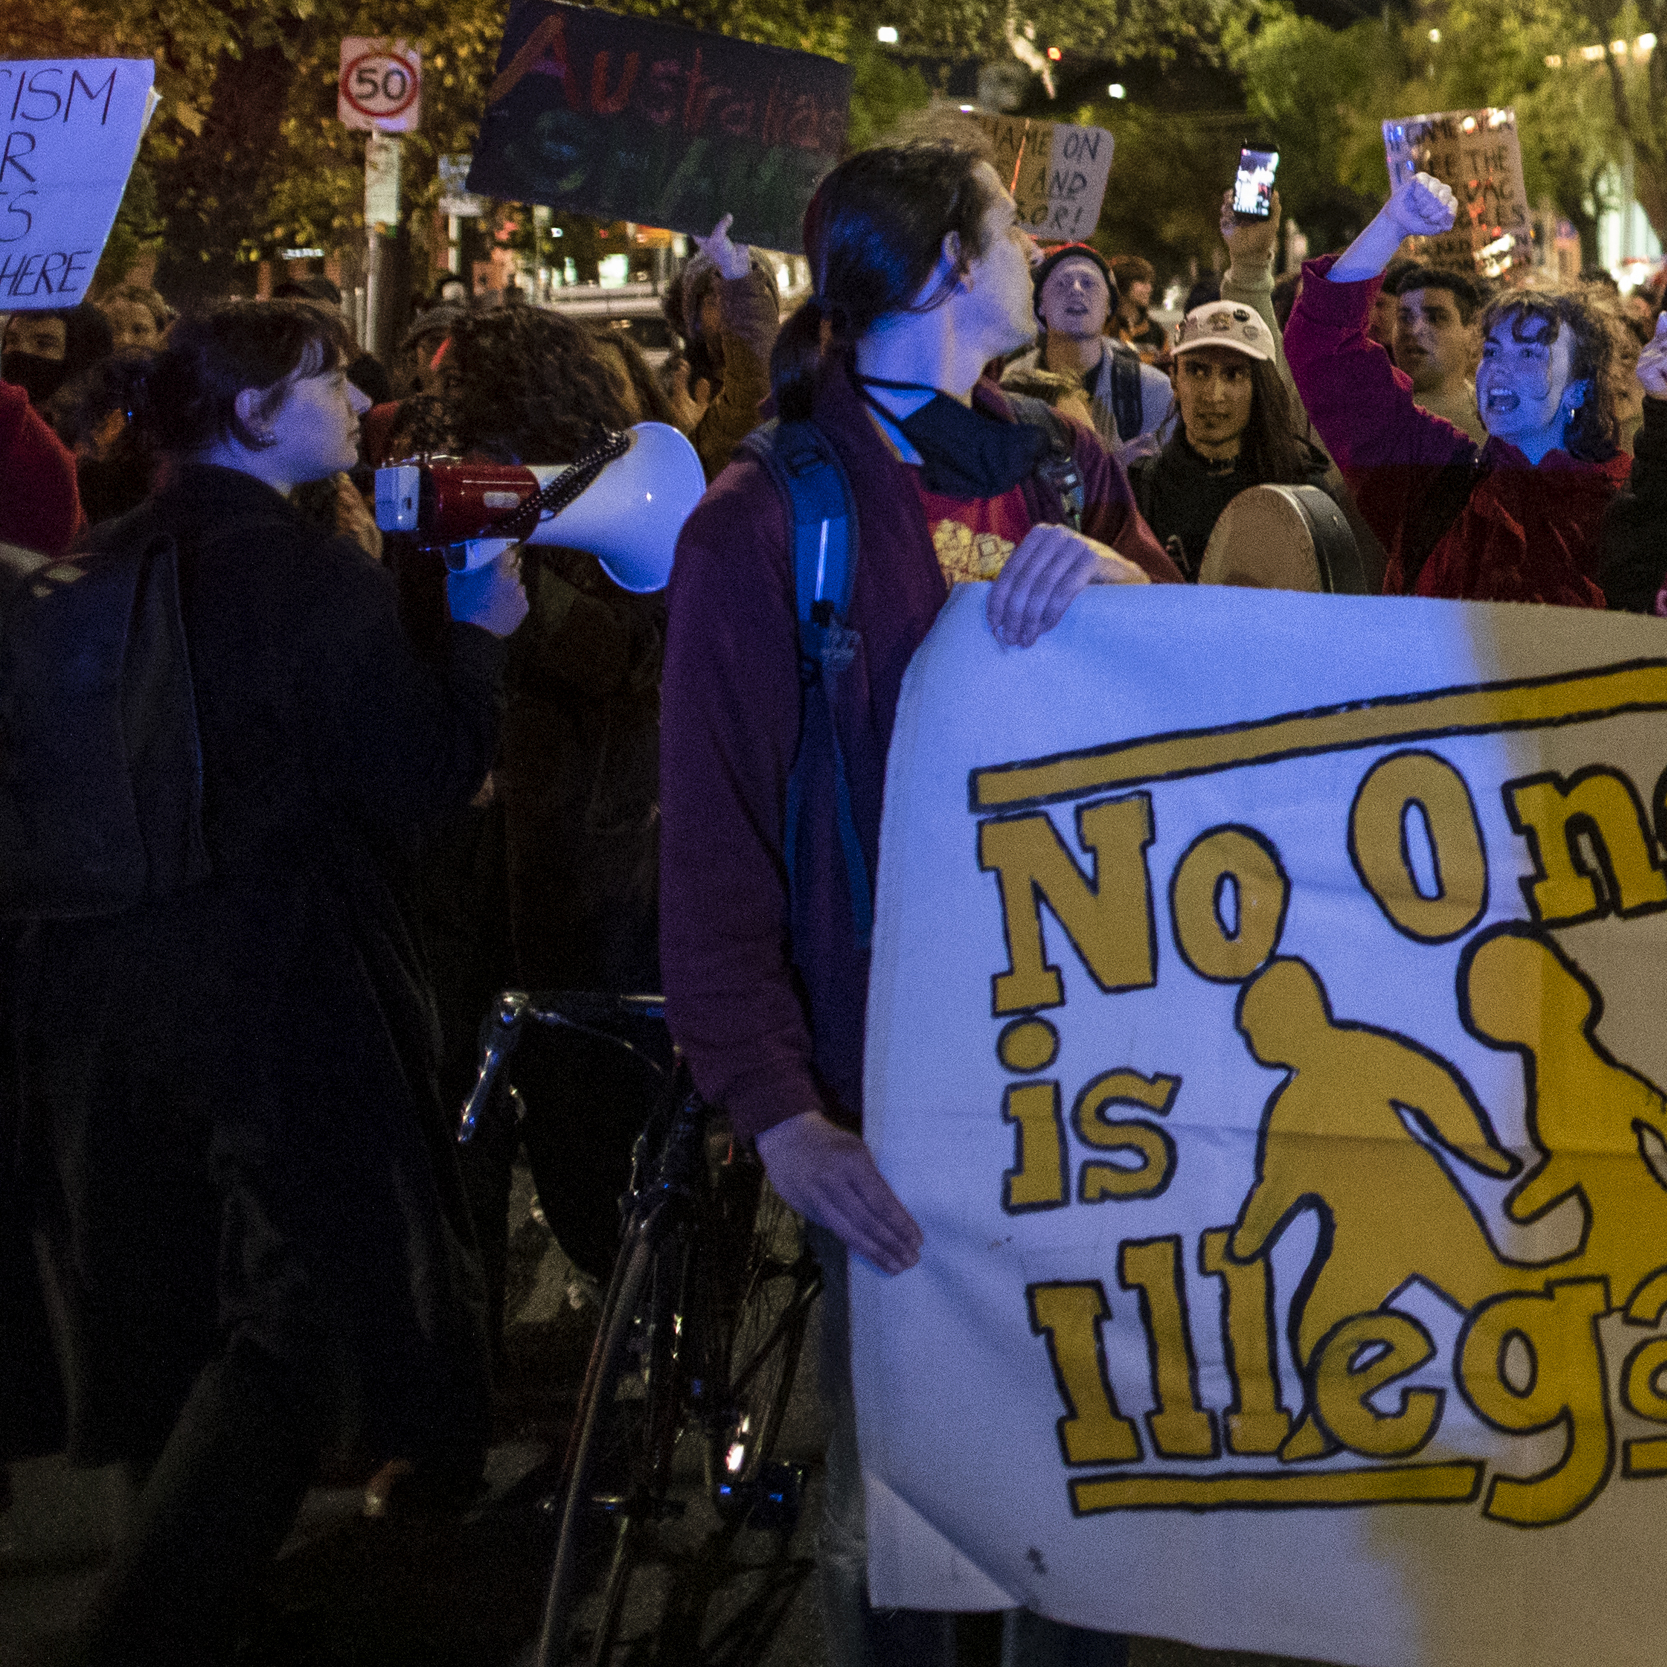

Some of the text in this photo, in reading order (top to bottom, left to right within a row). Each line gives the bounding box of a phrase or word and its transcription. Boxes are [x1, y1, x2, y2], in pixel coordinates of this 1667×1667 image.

[0, 68, 117, 125] ISM
[355, 68, 407, 101] 50
[1063, 131, 1101, 163] ON
[978, 790, 1291, 1018] No
[995, 1016, 1182, 1214] is
